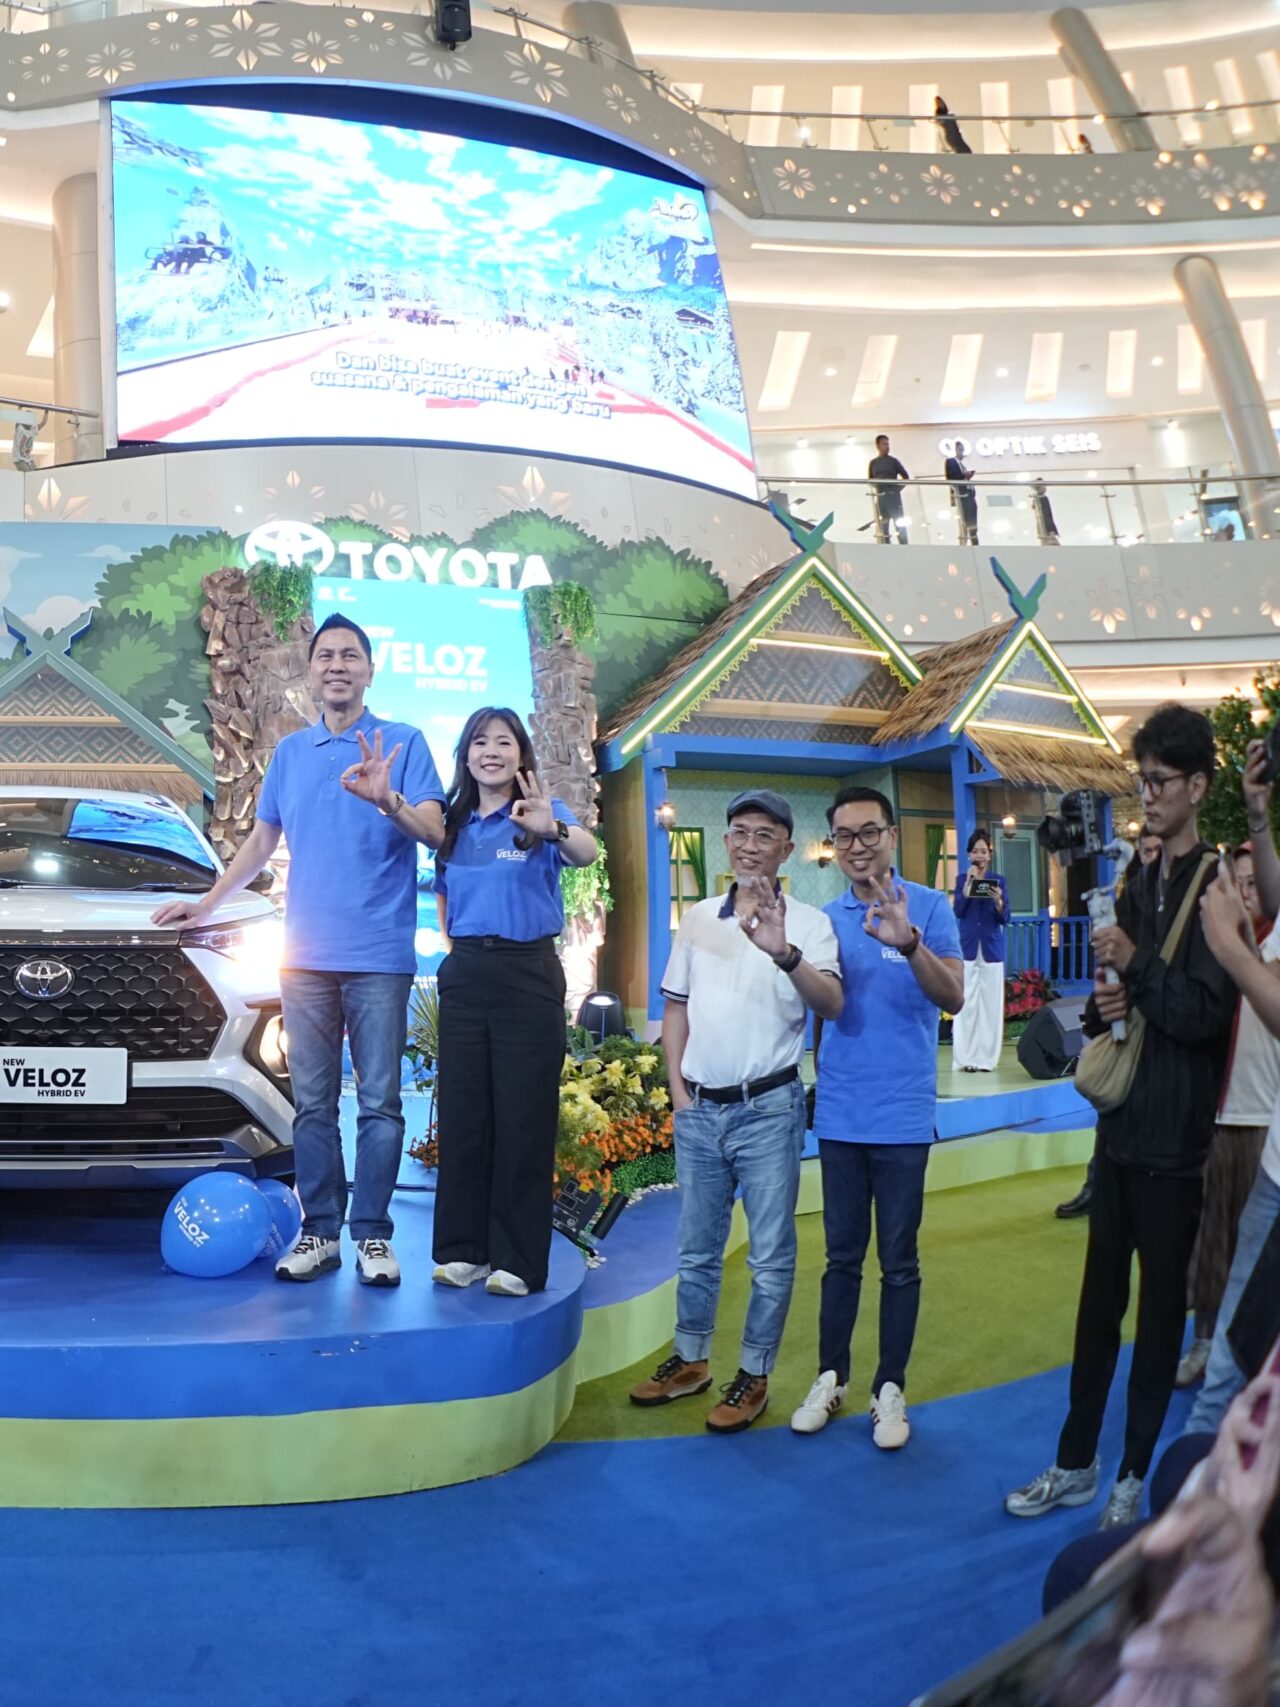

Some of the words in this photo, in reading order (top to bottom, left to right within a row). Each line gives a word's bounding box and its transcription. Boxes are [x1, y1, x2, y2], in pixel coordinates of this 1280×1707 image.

[336, 351, 376, 370] Dan
[378, 354, 419, 374] bisa
[311, 371, 390, 390] suasana
[392, 374, 409, 391] &
[524, 391, 570, 414] yang
[571, 399, 612, 418] baru
[976, 436, 1048, 456] OPTIK
[338, 541, 554, 591] TOYOTA
[3, 1068, 87, 1087] VELOZ
[174, 1200, 210, 1245] VELOZ
